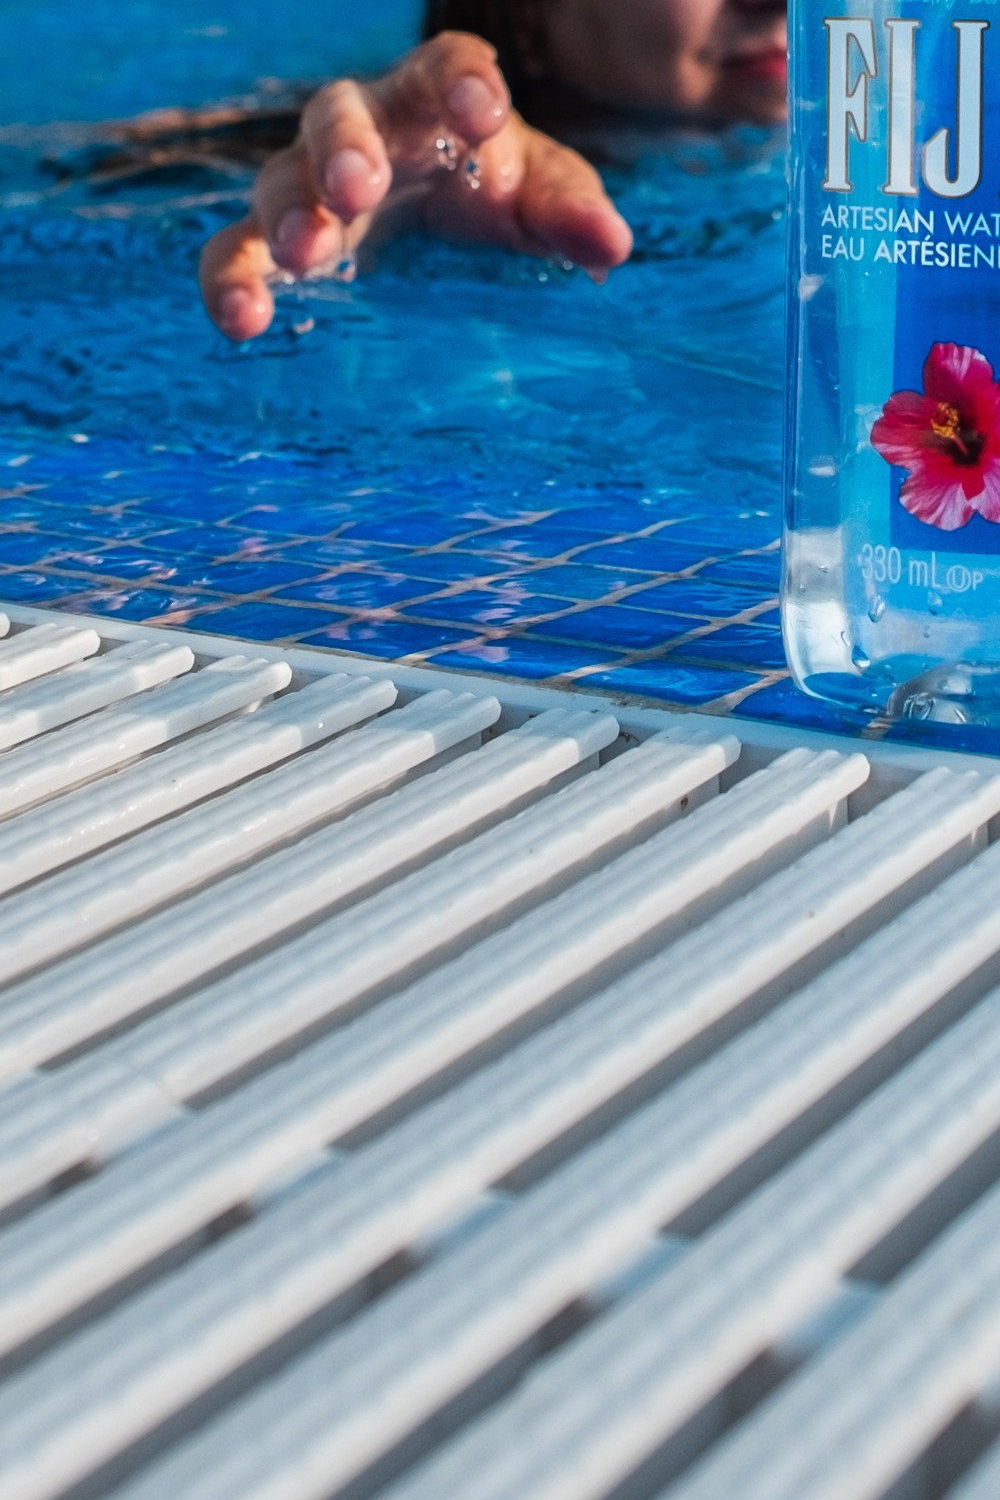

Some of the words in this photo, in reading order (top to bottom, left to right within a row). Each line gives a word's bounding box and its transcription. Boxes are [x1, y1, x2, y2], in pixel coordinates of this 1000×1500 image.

[821, 204, 935, 236] ARTESIAN
[821, 234, 865, 261] EAU
[861, 544, 901, 584] 330
[908, 551, 941, 588] mL
